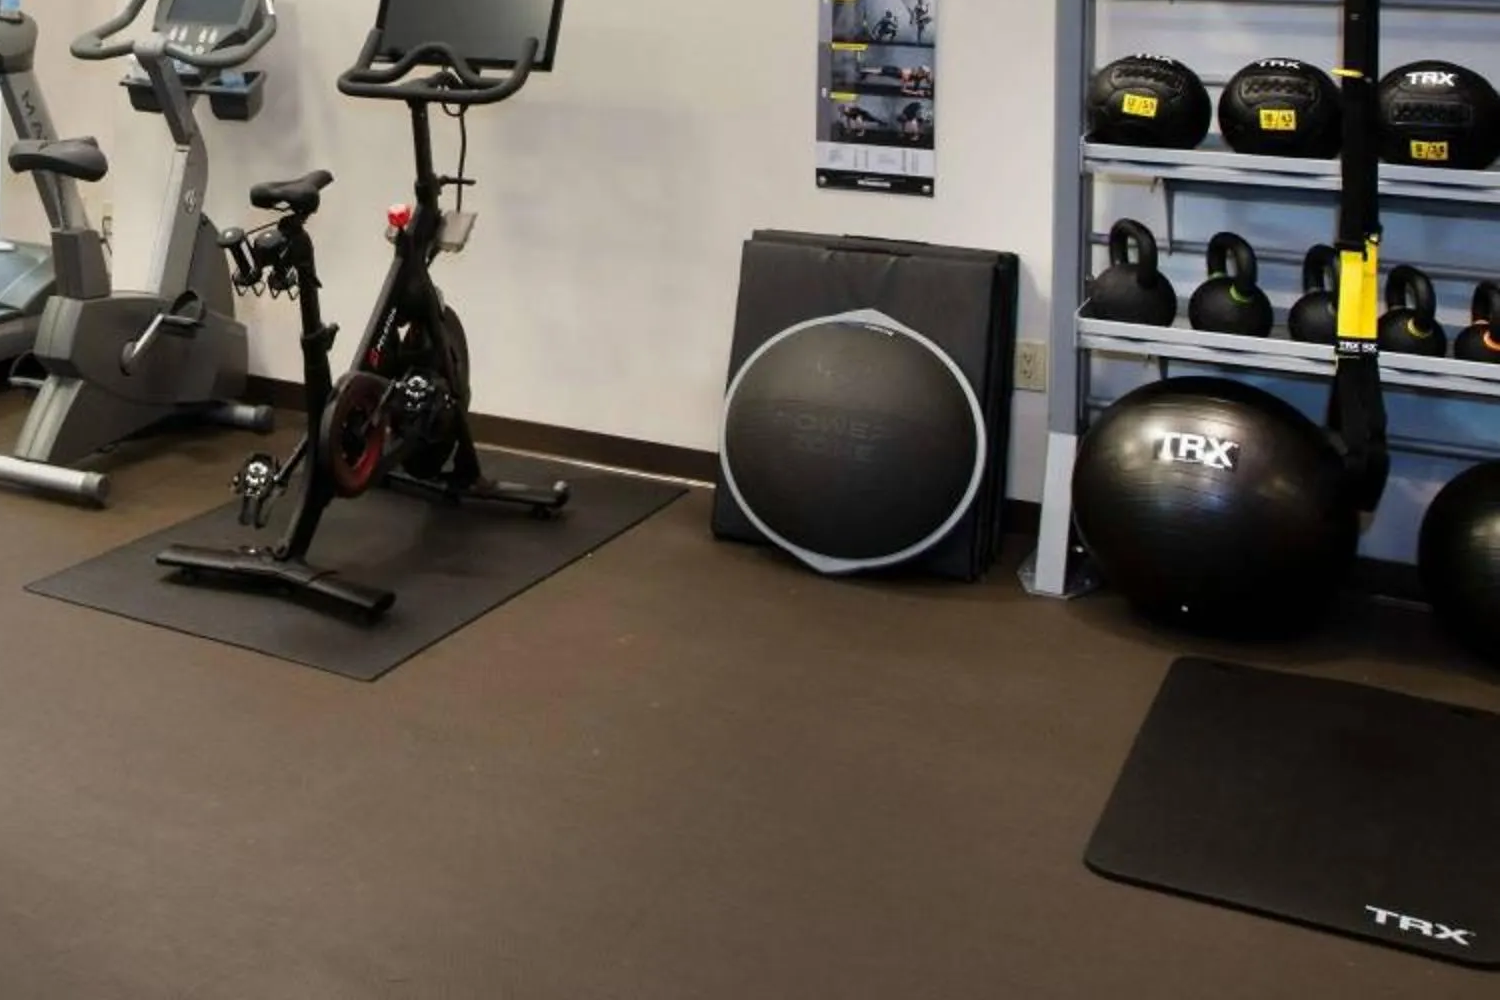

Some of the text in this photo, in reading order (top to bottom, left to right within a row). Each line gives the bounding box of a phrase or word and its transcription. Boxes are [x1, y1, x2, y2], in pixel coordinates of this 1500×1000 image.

[1405, 71, 1456, 87] TRX
[1157, 431, 1240, 470] TRX
[1365, 904, 1472, 946] TRX
